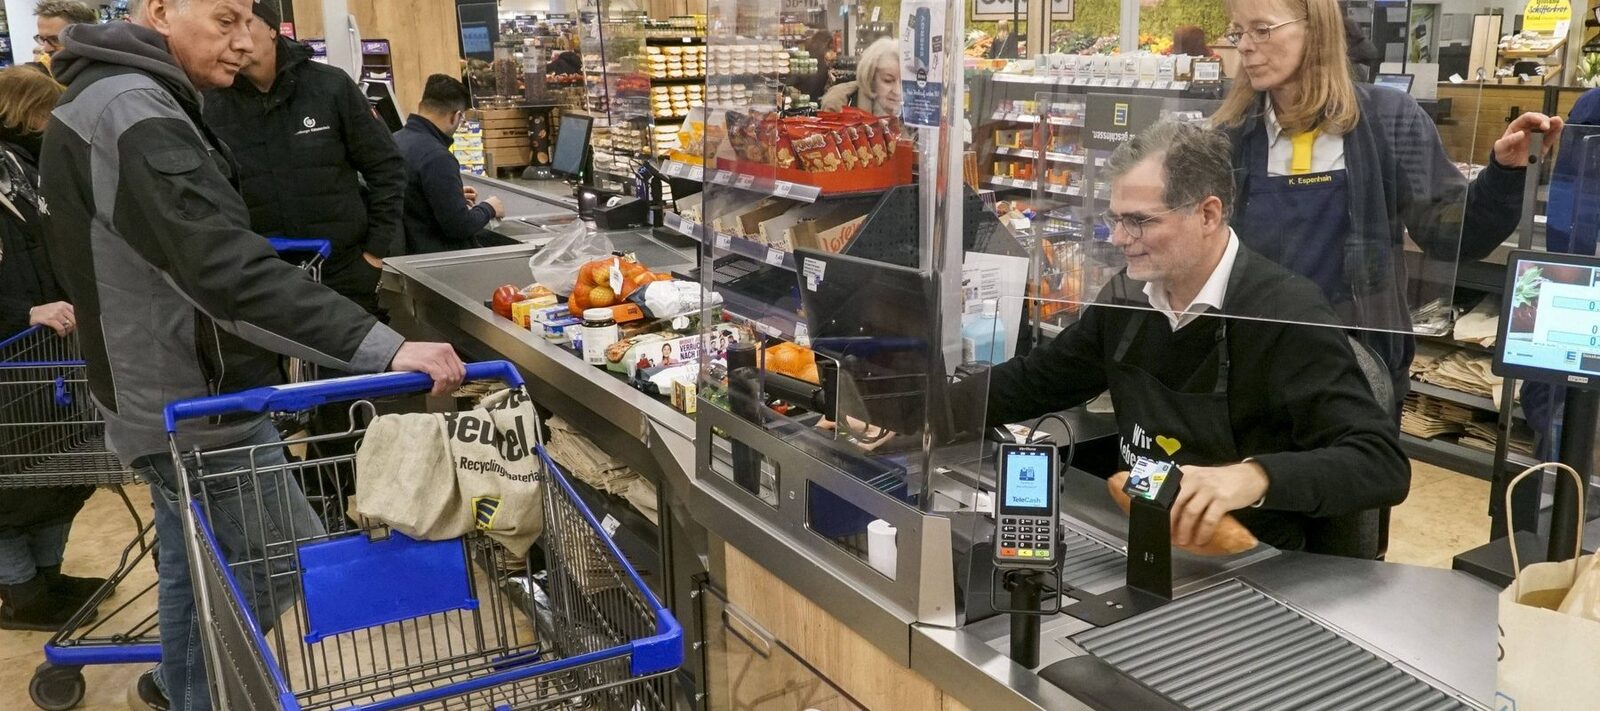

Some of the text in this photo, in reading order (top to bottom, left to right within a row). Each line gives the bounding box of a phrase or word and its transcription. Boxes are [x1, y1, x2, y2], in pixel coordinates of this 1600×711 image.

[1297, 174, 1332, 185] Espenhain
[1132, 423, 1153, 450] Wir
[460, 456, 542, 483] Recyclingmateria
